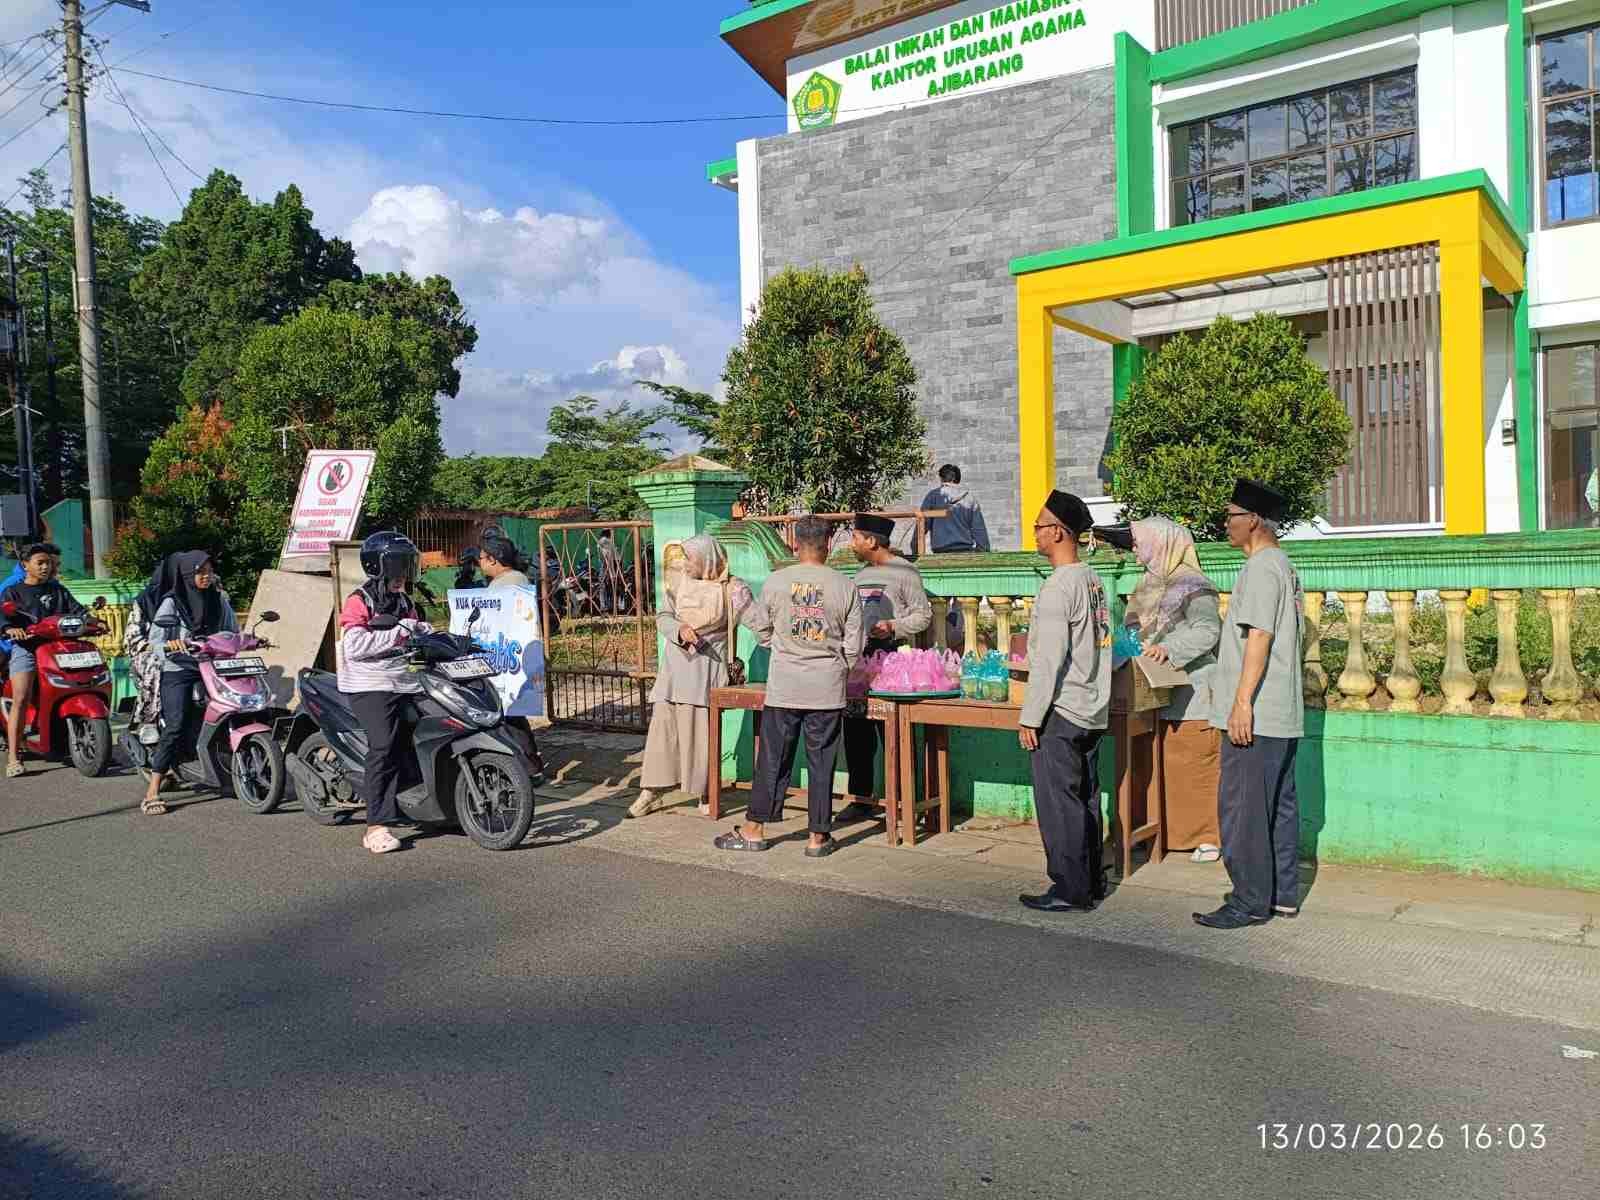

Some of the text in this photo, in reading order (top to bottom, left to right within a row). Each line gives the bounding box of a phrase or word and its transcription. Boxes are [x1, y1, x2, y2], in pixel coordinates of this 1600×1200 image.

[844, 46, 890, 75] BALAI
[894, 28, 945, 60] NIKAH
[950, 15, 984, 41] DAN
[989, 0, 1070, 29] MANASI
[871, 9, 1087, 91] KANTOR URUSAN AGAMA
[927, 53, 1024, 98] AJIBARANG
[455, 597, 469, 610] KUA
